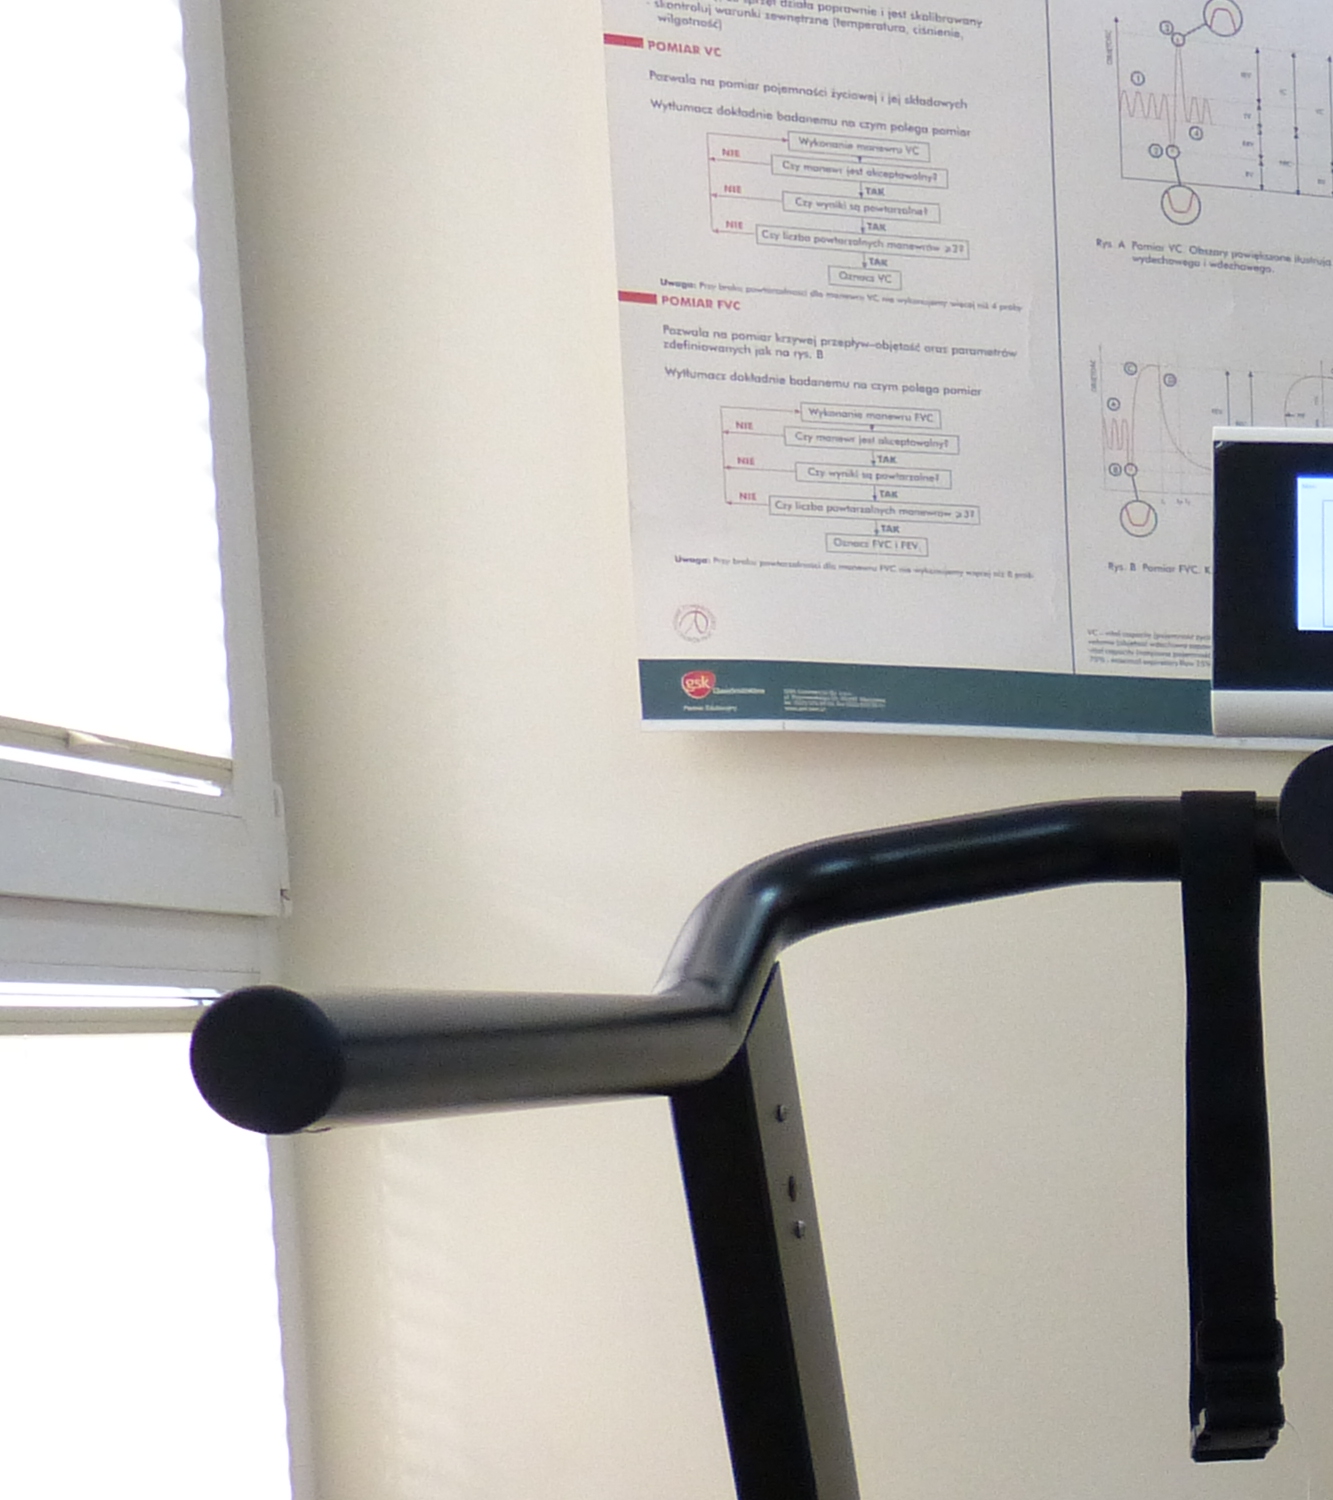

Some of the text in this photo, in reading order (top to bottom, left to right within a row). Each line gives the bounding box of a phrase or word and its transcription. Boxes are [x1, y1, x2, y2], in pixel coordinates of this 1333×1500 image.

[716, 7, 761, 19] warunki
[888, 10, 906, 20] jest
[648, 40, 721, 57] POMIAR VC
[701, 78, 715, 87] na
[719, 78, 759, 90] pomiar
[842, 119, 855, 128] na
[859, 121, 886, 132] czym
[932, 126, 970, 138] pomiar
[722, 148, 740, 157] NIE
[905, 145, 920, 156] VC
[782, 160, 799, 172] Czy
[724, 185, 741, 194] NIE
[866, 187, 885, 196] TAK
[795, 197, 812, 208] Czy
[726, 220, 743, 229] NIE
[867, 222, 886, 231] TAK
[762, 230, 779, 241] Czy
[869, 257, 887, 267] TAK
[878, 274, 892, 284] VC
[662, 295, 741, 310] POMIAR FVC
[713, 330, 727, 339] na
[731, 331, 771, 343] pomiar
[755, 346, 772, 358] jak
[776, 349, 789, 358] na
[817, 350, 824, 360] B
[854, 381, 866, 389] na
[871, 383, 898, 393] czym
[943, 386, 982, 397] pomiar
[914, 413, 934, 423] FVC
[736, 421, 753, 430] NIE
[795, 432, 812, 443] Czy
[737, 457, 755, 465] NIE
[878, 455, 897, 463] TAK
[808, 467, 825, 478] Czy
[739, 492, 756, 501] NIE
[879, 490, 898, 498] TAK
[775, 501, 792, 511] Czy
[881, 525, 899, 533] TAK
[872, 538, 892, 549] FVC
[686, 674, 710, 690] gsk
